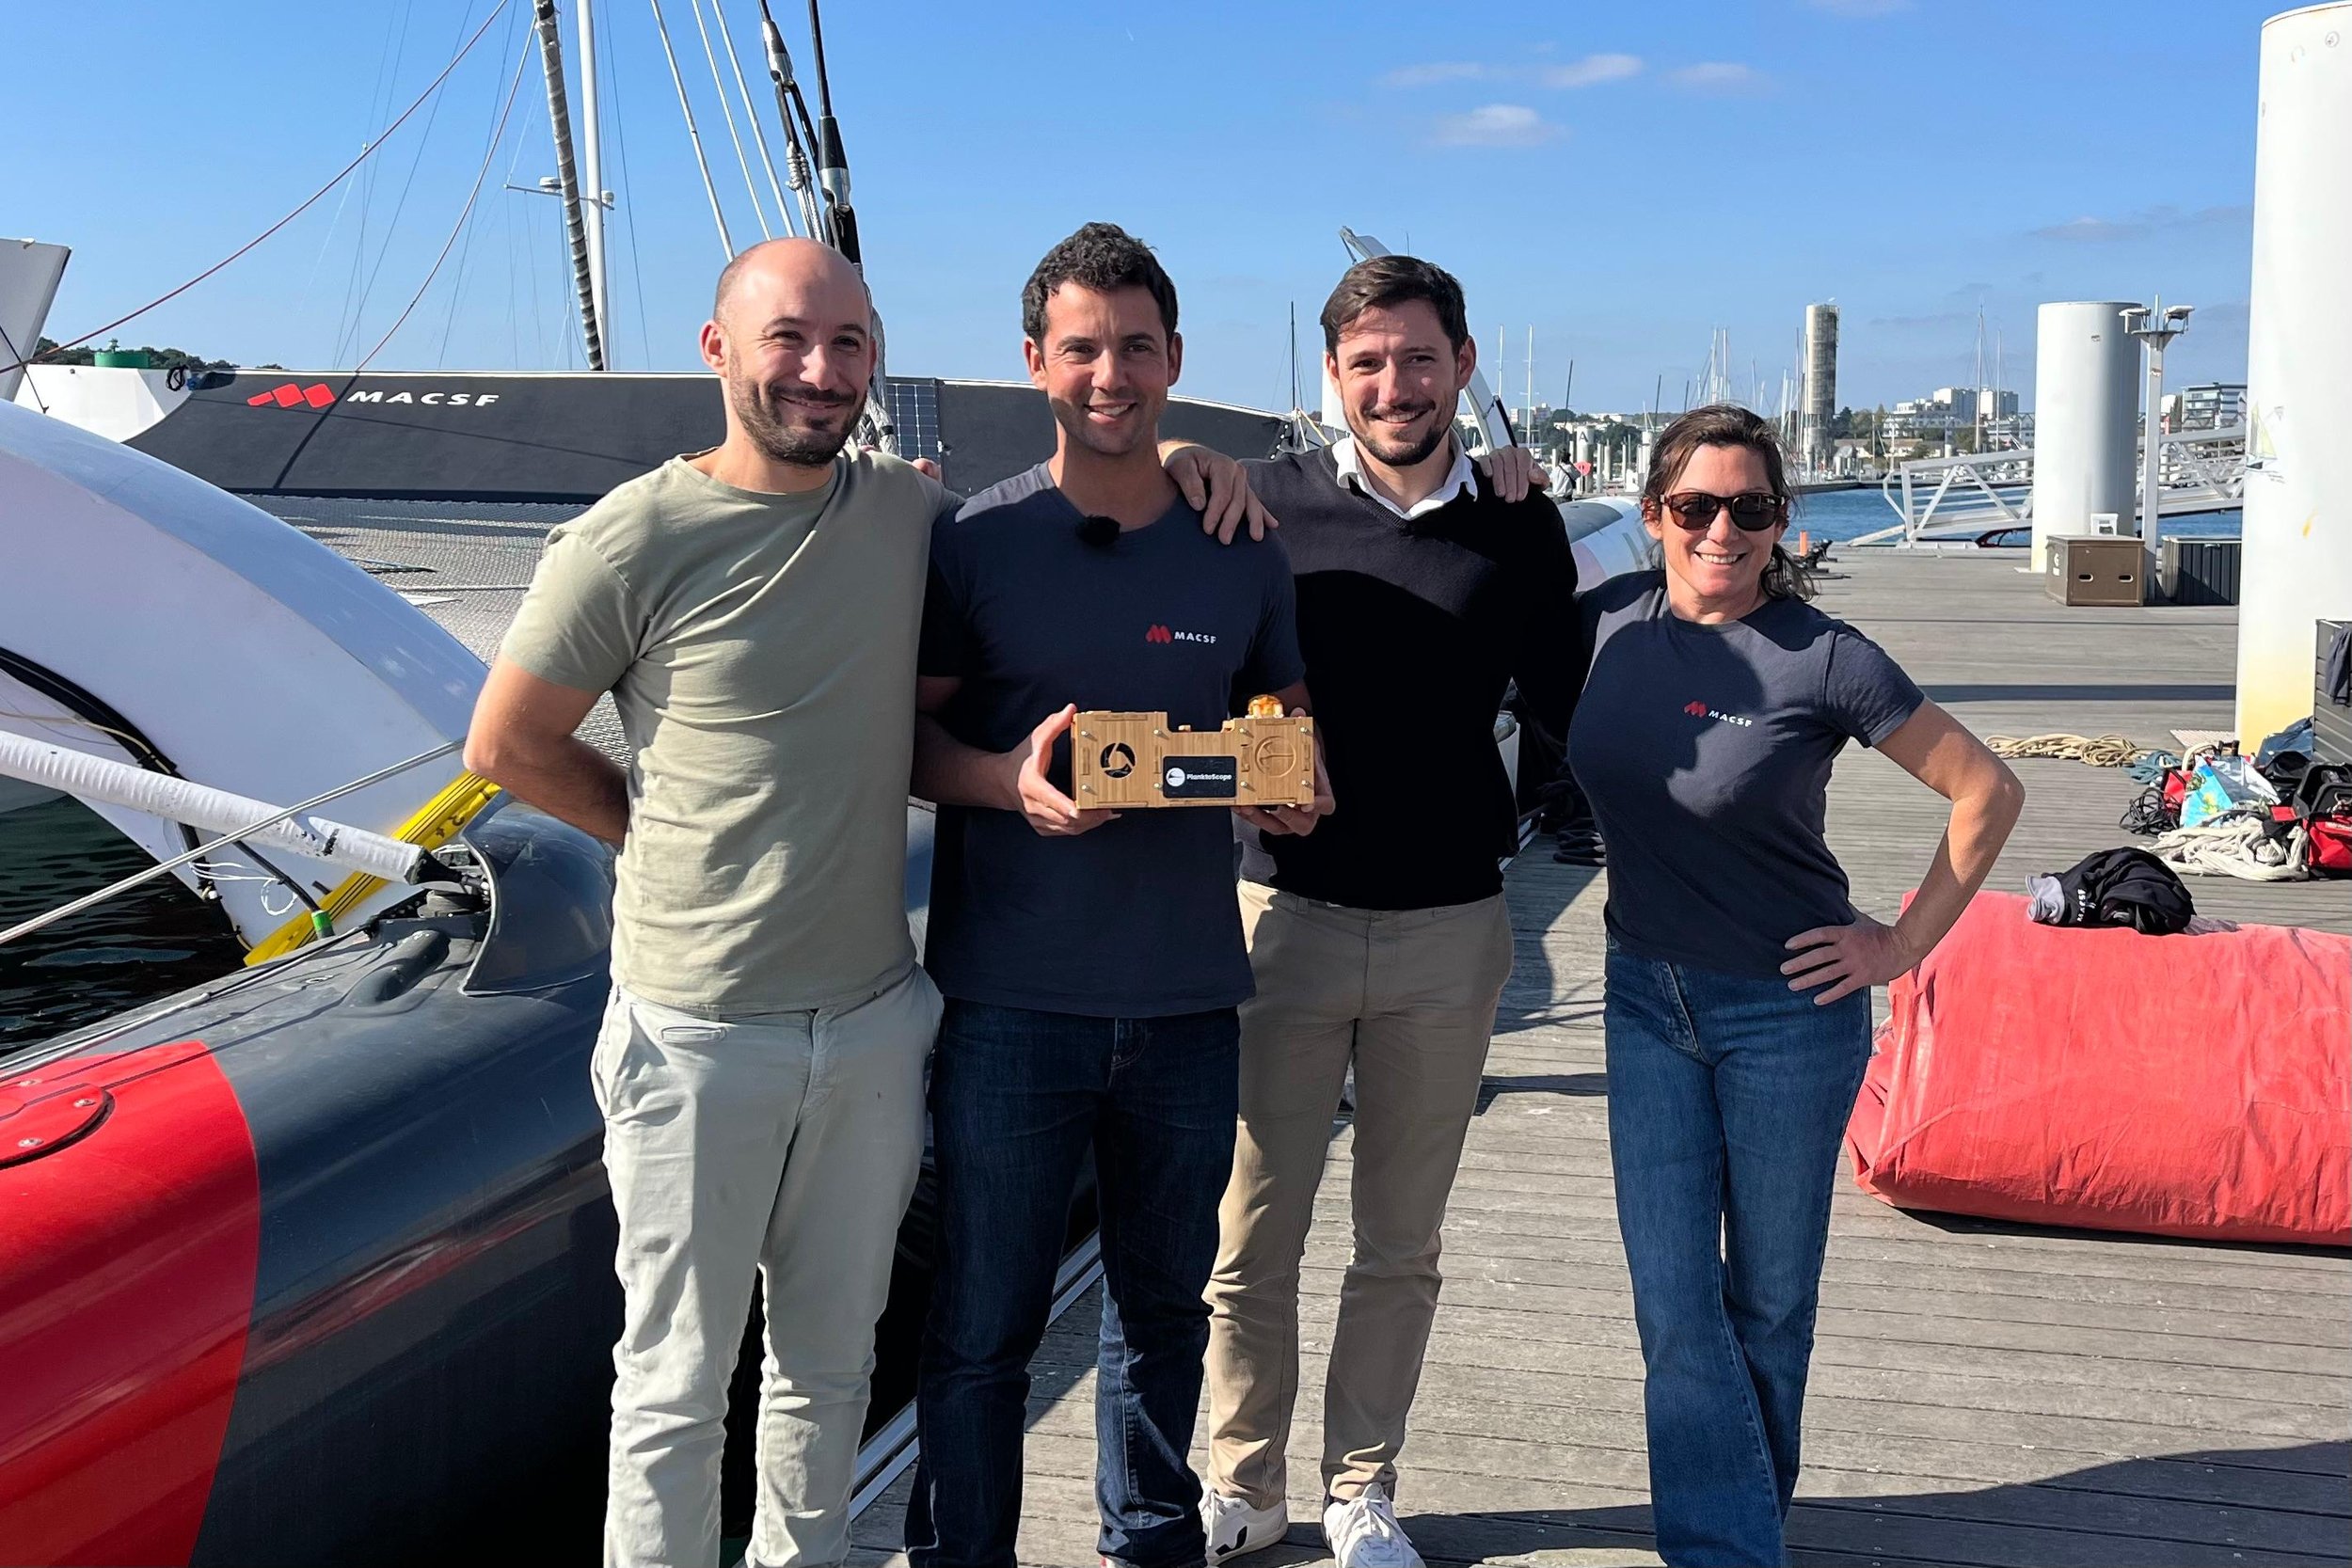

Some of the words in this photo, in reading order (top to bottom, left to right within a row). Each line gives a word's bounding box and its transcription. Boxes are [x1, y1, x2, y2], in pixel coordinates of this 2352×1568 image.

[346, 390, 500, 406] MACSF
[1579, 431, 1589, 442] A
[1174, 631, 1216, 644] MACSF
[1708, 709, 1753, 727] MACSF
[1186, 773, 1232, 783] PlanktoScope
